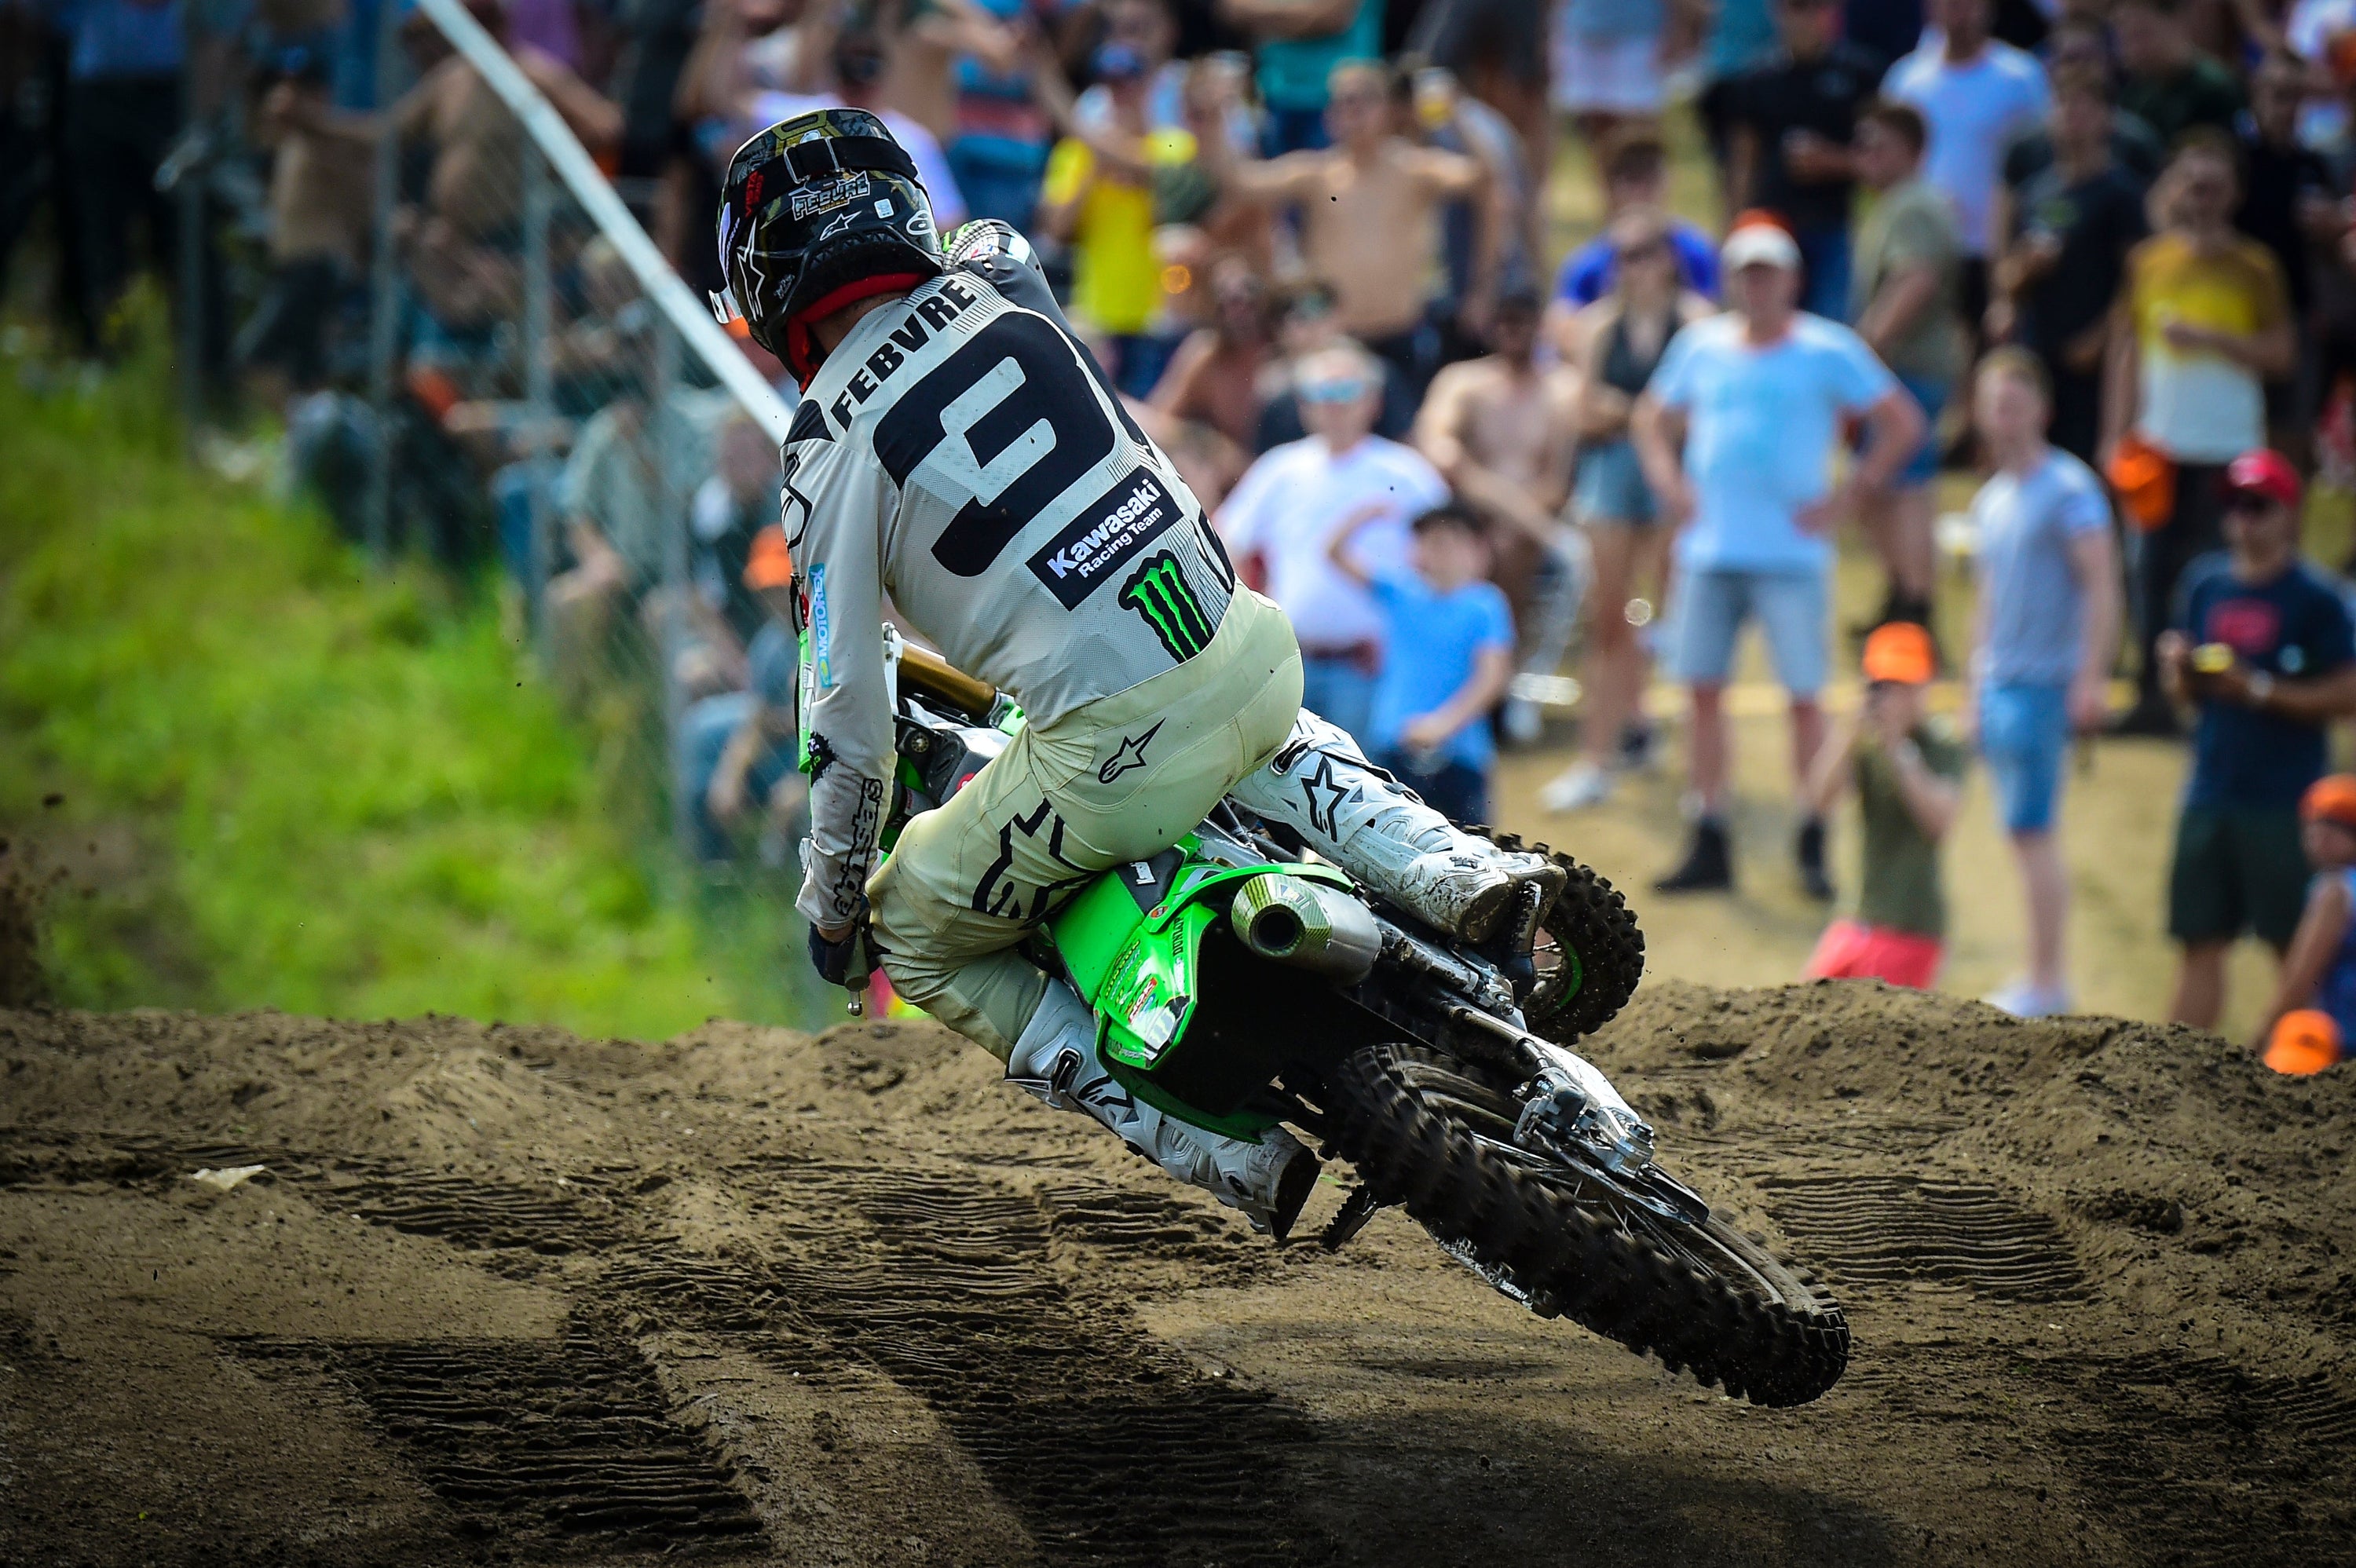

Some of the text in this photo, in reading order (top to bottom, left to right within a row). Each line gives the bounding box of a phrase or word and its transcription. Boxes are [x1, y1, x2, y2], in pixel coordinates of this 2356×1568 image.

[829, 279, 976, 432] FEBVRE
[873, 311, 1116, 577] 3
[1046, 479, 1162, 579] Kawasaki
[1077, 507, 1163, 578] Racing Team
[812, 567, 829, 656] MOTOREX
[1173, 917, 1184, 957] DUNLOP
